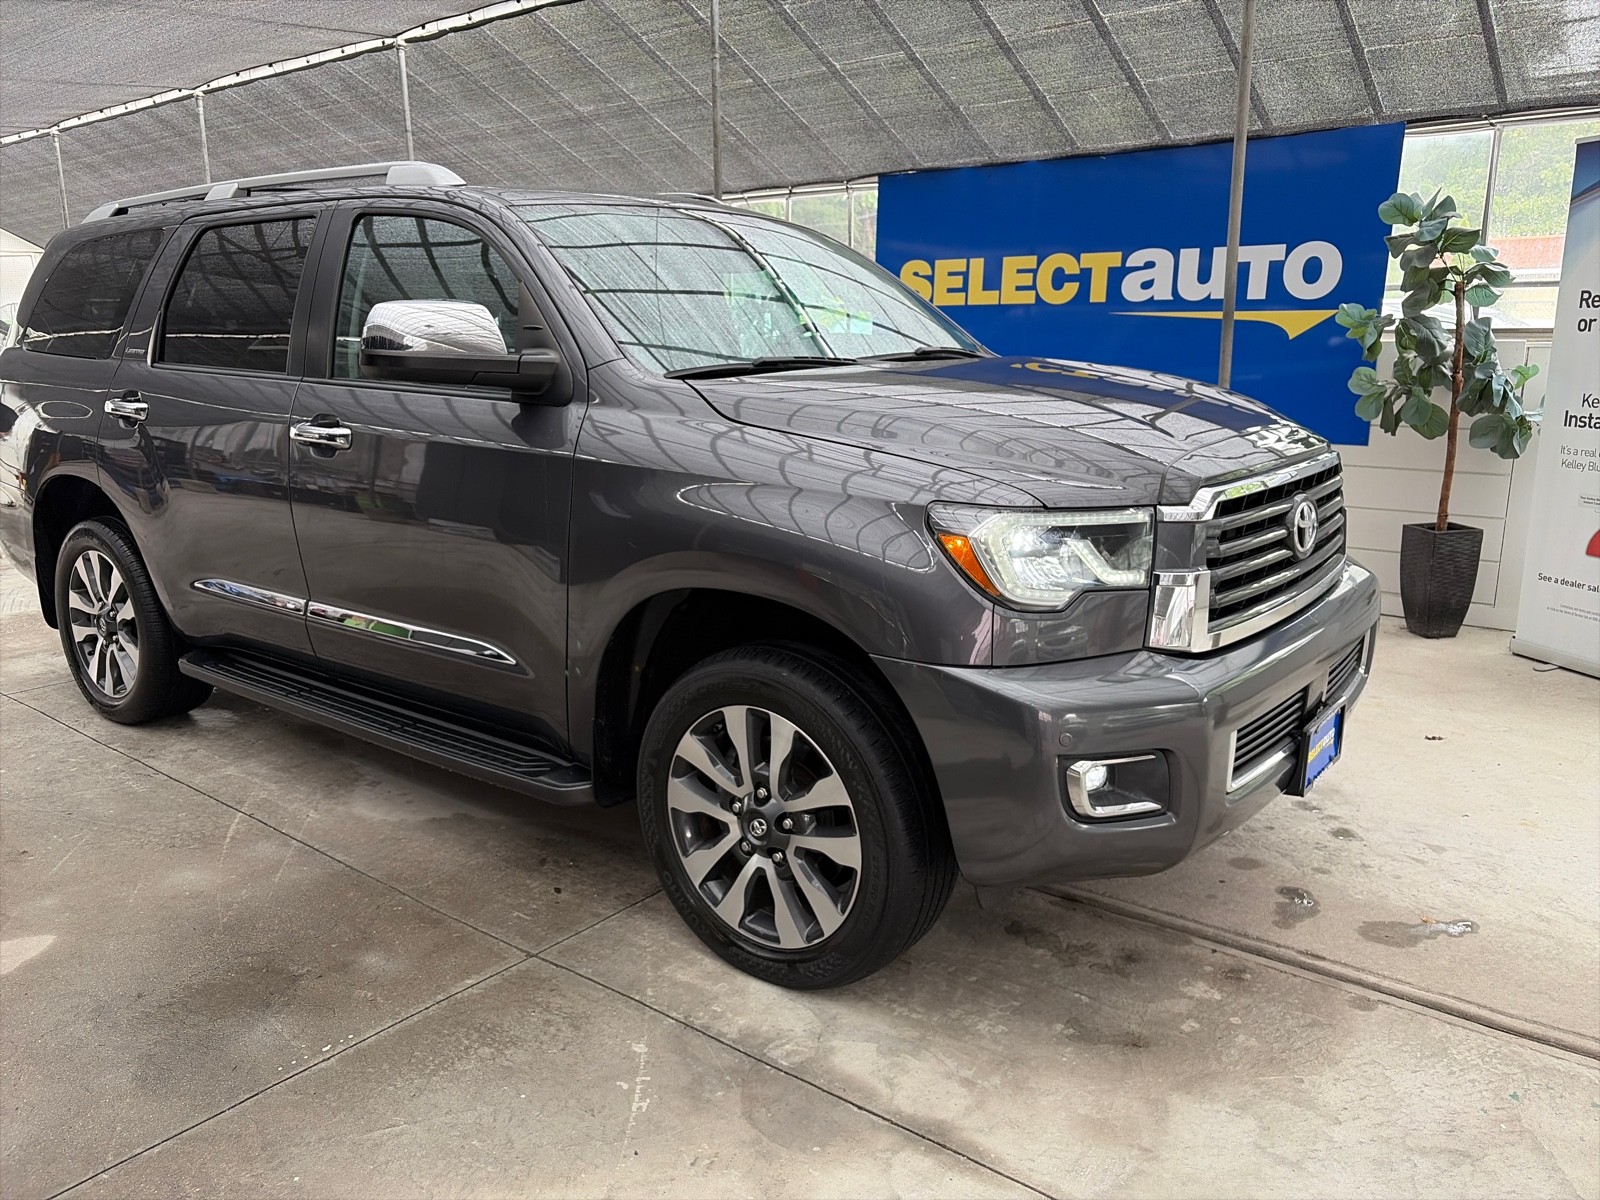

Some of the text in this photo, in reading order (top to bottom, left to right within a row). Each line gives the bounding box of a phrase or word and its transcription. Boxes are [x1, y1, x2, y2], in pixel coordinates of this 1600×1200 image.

[1579, 290, 1600, 308] Re
[1577, 318, 1598, 332] or
[1581, 393, 1600, 408] Ke
[1563, 410, 1600, 429] Insta
[1572, 448, 1579, 456] a
[1580, 448, 1597, 458] real
[1561, 458, 1587, 472] Kelley
[1537, 572, 1553, 582] See
[1553, 576, 1559, 584] a
[1560, 577, 1587, 589] dealer
